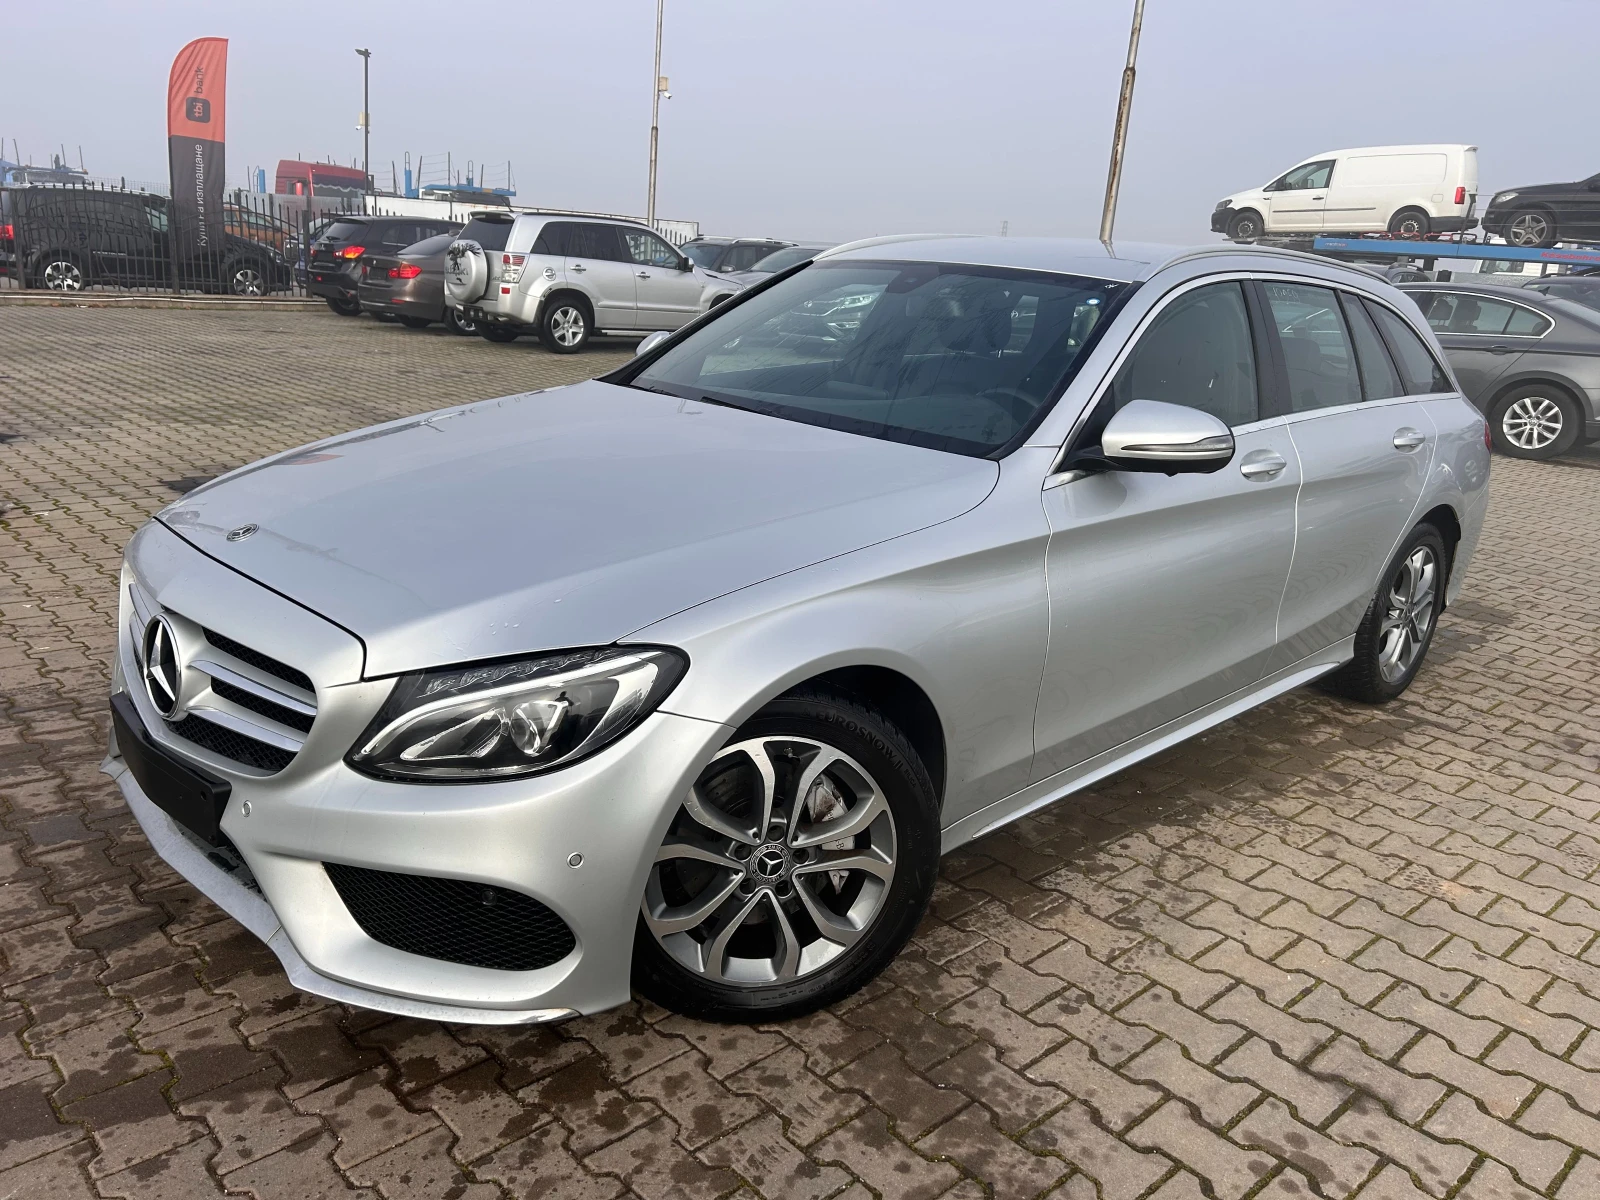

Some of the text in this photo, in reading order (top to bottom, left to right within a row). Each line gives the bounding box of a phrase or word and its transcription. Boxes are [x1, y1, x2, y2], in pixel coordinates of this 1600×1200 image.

[193, 66, 204, 118] tbi bank
[194, 144, 205, 204] изплащане
